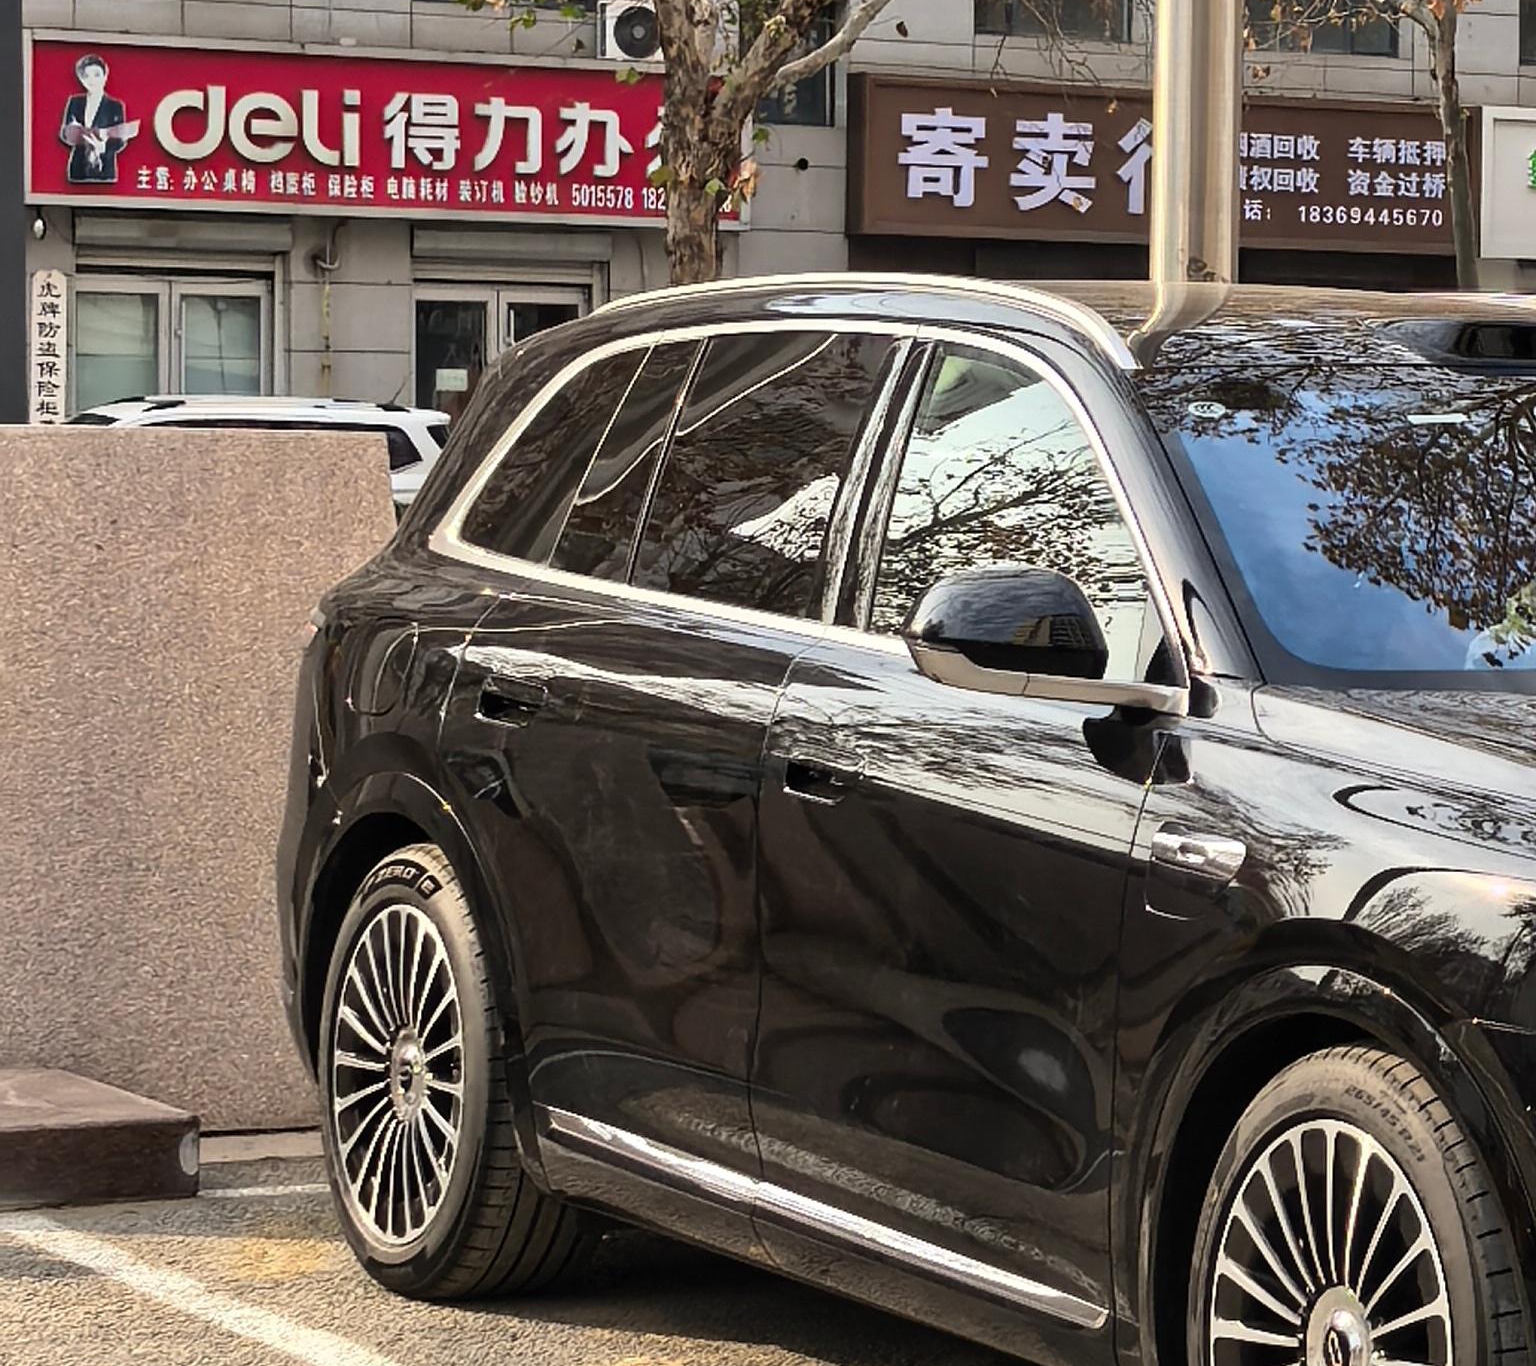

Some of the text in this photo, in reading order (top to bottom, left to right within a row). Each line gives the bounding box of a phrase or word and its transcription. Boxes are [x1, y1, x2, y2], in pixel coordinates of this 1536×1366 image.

[152, 84, 665, 177] deli 得力办
[1347, 136, 1446, 166] 车辆抵押
[572, 183, 634, 209] 5015578
[1347, 169, 1446, 199] 资金过桥
[1298, 206, 1443, 227] 18369445670
[35, 281, 63, 424] 虎牌防盗保险柜
